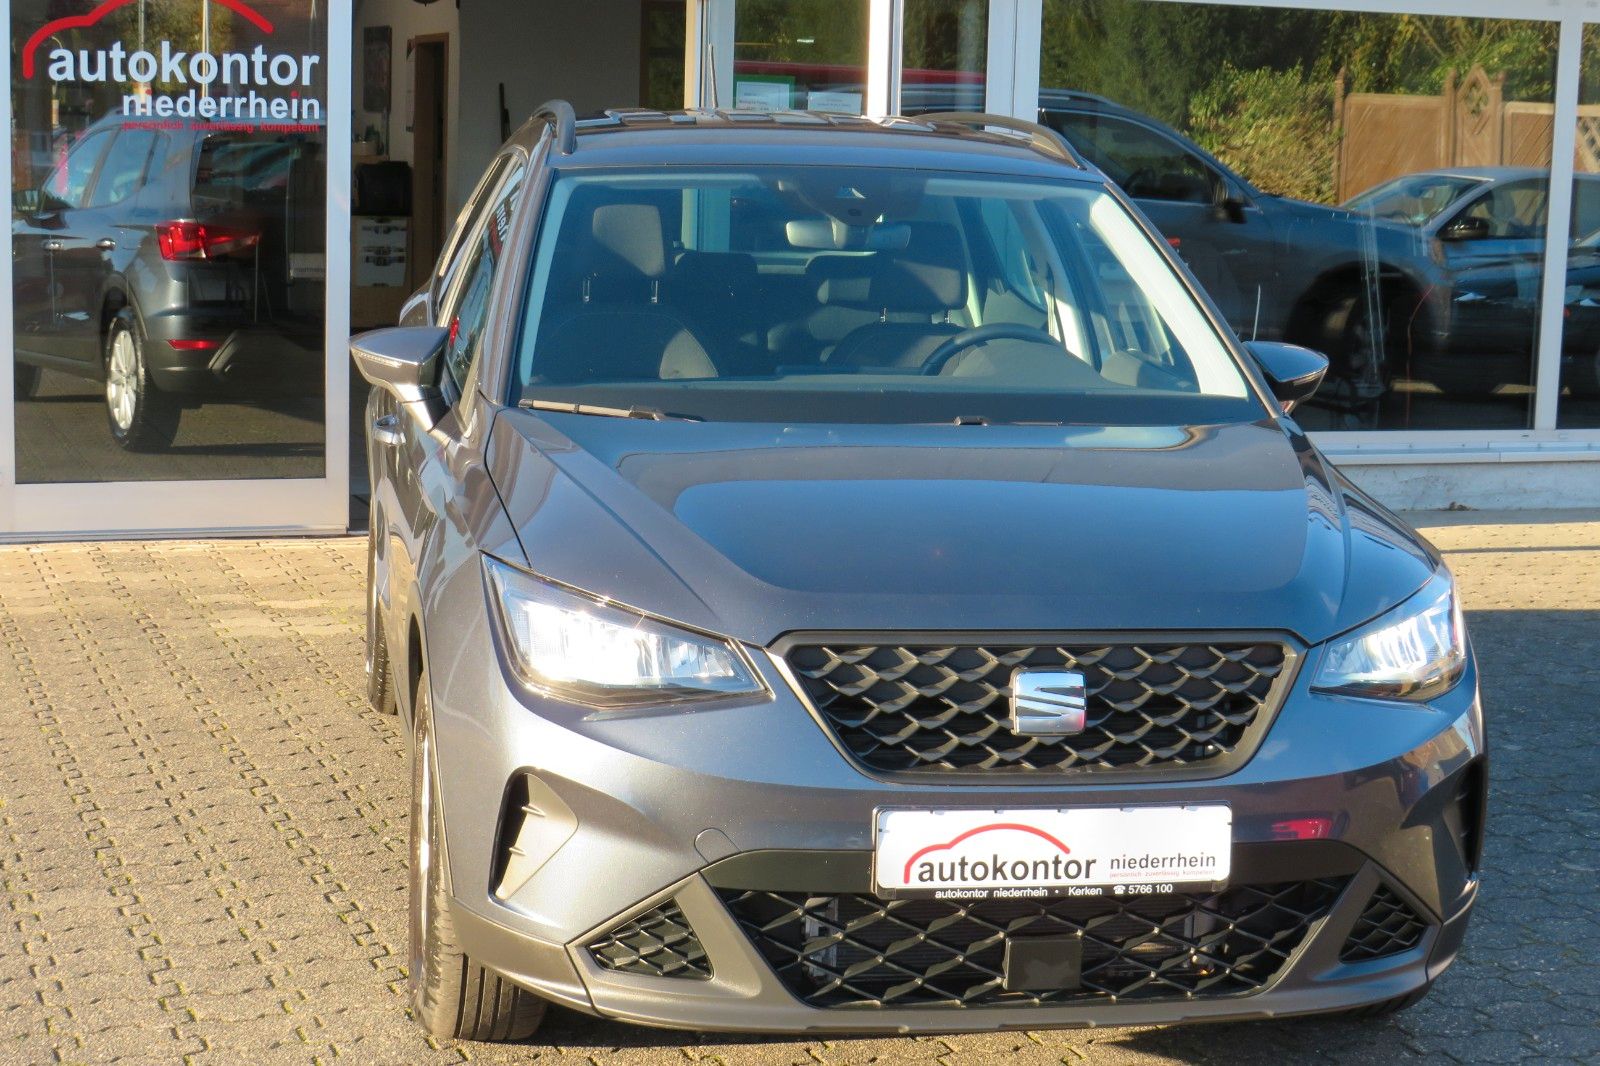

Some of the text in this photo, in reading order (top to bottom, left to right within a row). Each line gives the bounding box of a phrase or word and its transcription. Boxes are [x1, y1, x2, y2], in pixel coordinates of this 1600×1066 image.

[48, 41, 320, 86] autokontor
[122, 89, 320, 120] niederrhein
[918, 851, 1216, 882] autokontor niederrhein
[935, 884, 1173, 899] autokontor niederrhein Kerken 5766 100
